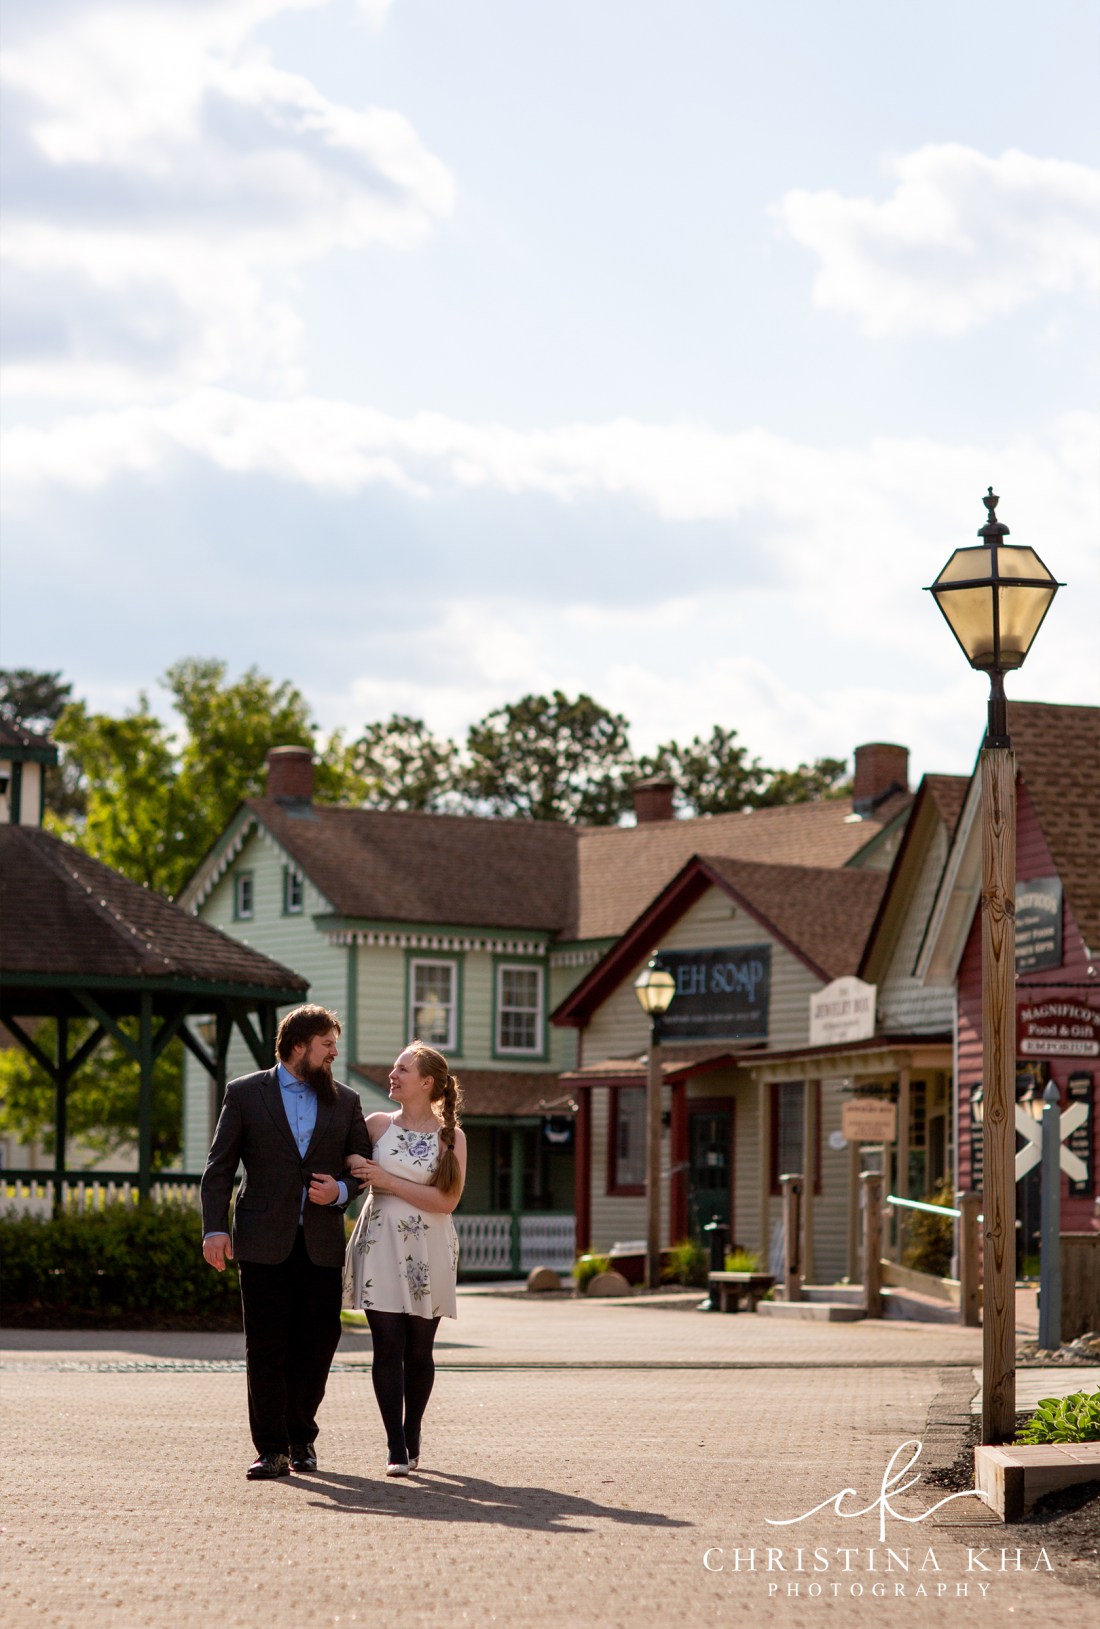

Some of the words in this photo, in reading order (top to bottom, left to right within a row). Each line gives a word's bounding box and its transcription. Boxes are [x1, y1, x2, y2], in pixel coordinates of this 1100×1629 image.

[665, 964, 706, 996] EH
[710, 960, 763, 1003] SOAP
[1021, 1003, 1100, 1026] MAGNIFICO'S
[1028, 1023, 1057, 1036] Food
[1059, 1024, 1069, 1037] &
[1071, 1024, 1094, 1037] Gift
[1026, 1041, 1094, 1052] EMPORIUM
